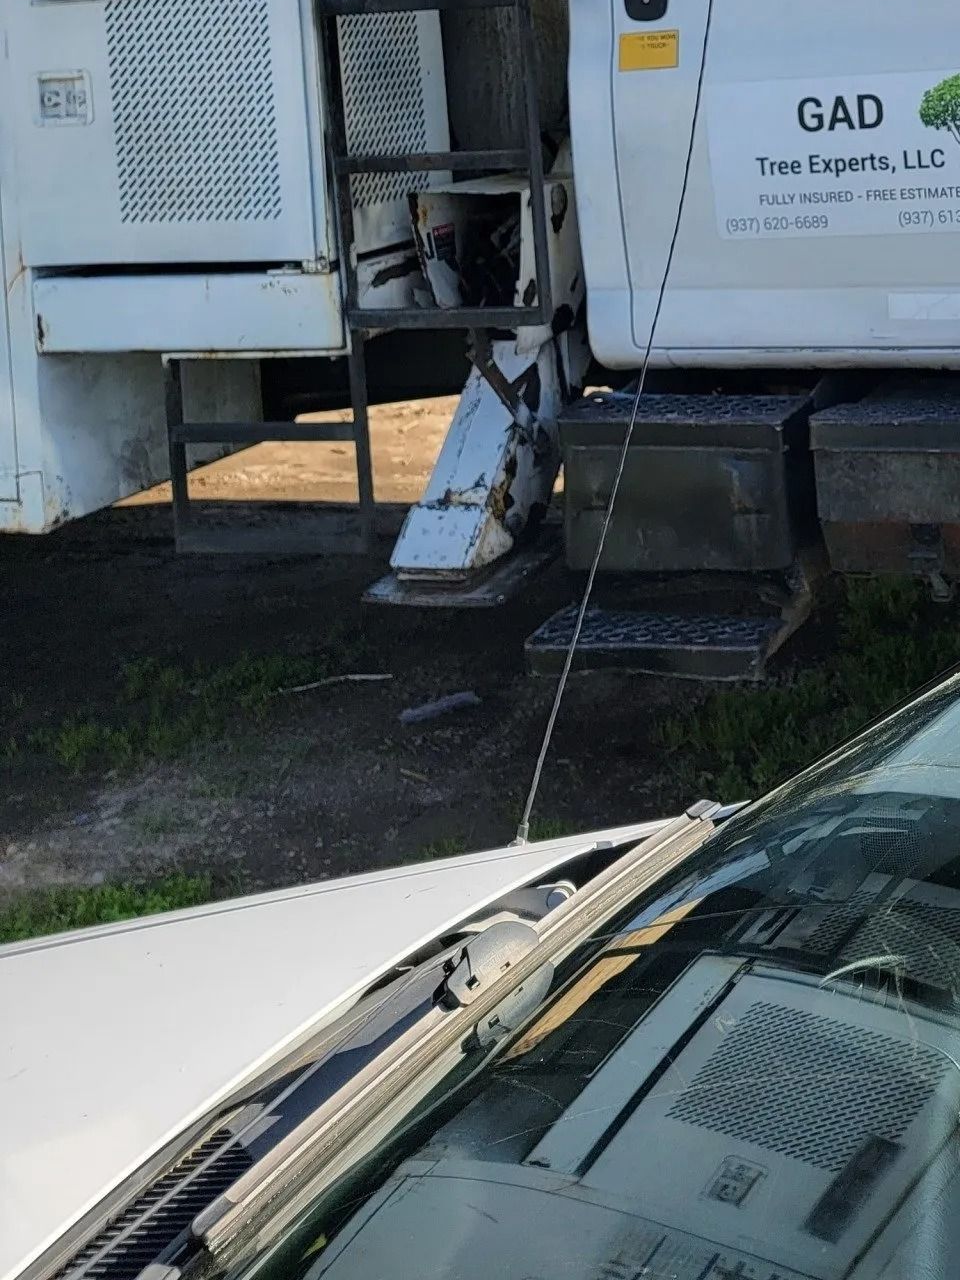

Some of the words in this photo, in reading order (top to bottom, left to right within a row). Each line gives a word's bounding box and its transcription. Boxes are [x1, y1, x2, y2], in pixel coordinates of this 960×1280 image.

[797, 94, 884, 132] GAD
[756, 157, 802, 176] Tree
[808, 153, 897, 178] Experts,
[903, 148, 946, 170] LLC
[759, 192, 796, 206] FULLY
[799, 191, 854, 204] INSURED
[865, 188, 897, 201] FREE
[725, 216, 761, 234] (937)
[763, 214, 829, 231] 620-6689
[897, 210, 935, 228] (937)
